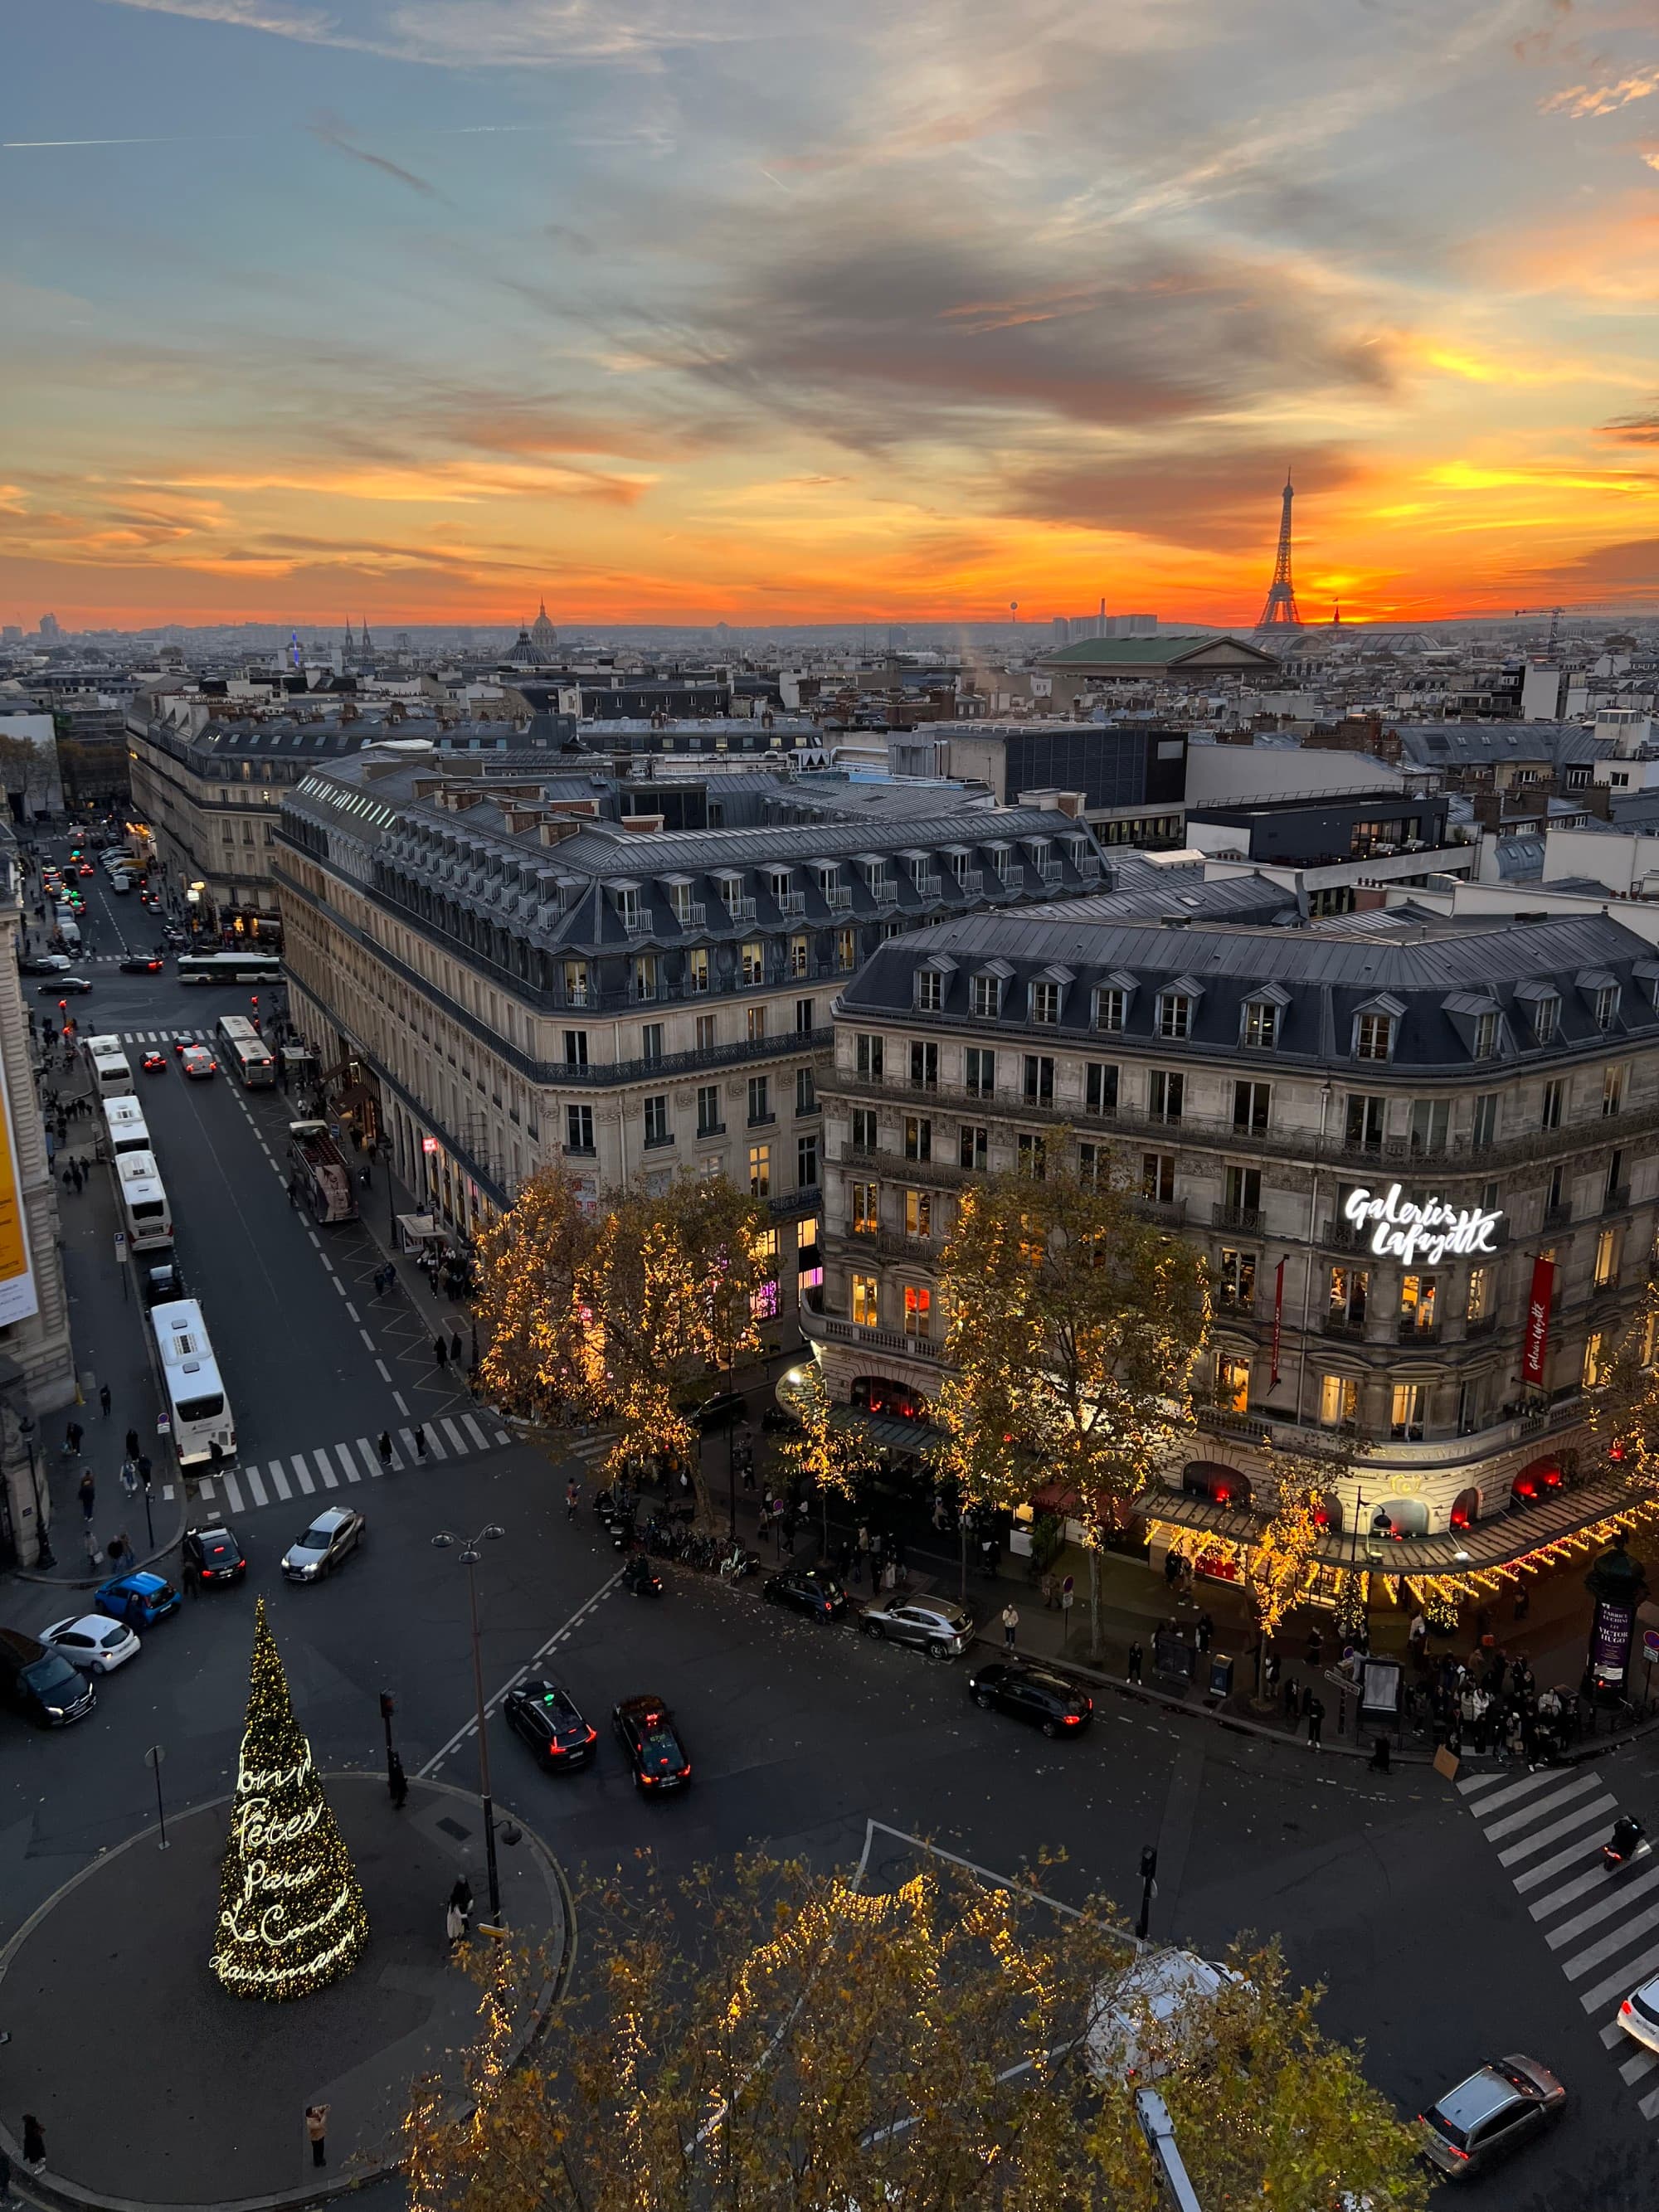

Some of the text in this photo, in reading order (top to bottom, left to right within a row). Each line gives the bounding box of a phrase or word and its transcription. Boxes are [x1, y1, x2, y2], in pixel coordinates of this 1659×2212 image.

[1345, 1183, 1457, 1230] Galeries
[1371, 1208, 1504, 1266] Lafayette
[1598, 1626, 1630, 1638] VICTOR
[1600, 1633, 1626, 1644] HUGO
[244, 1859, 322, 1901] Paris
[221, 1898, 260, 1943] Le
